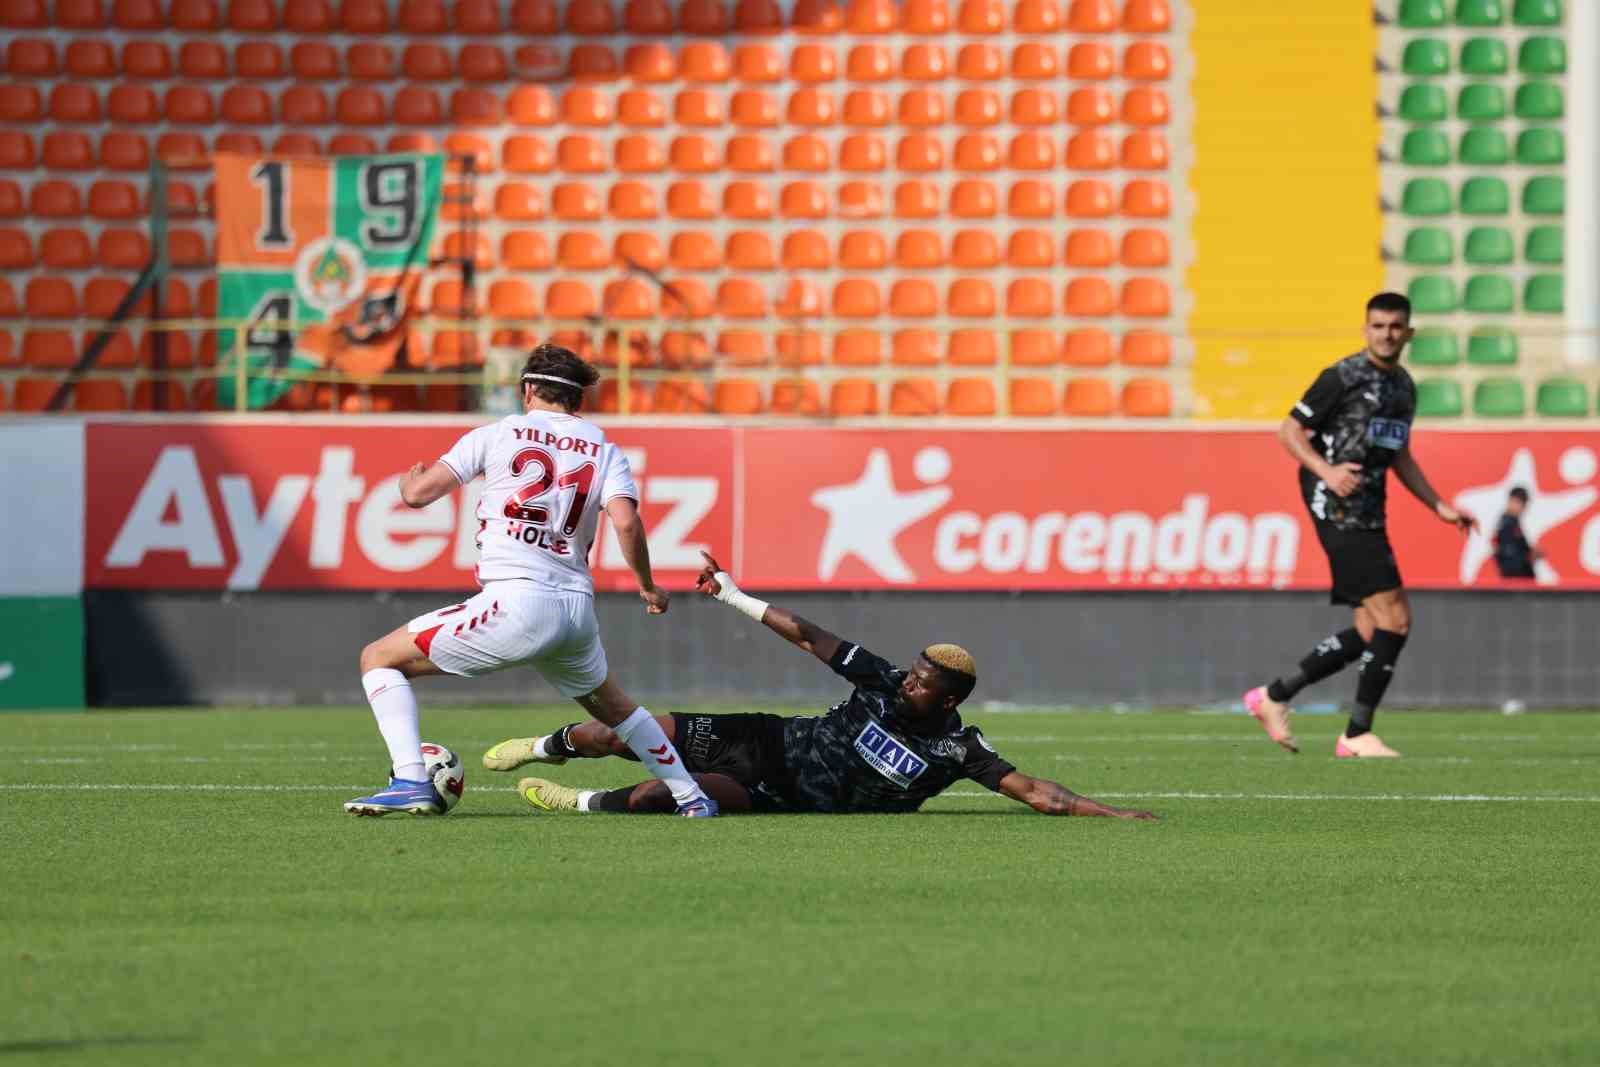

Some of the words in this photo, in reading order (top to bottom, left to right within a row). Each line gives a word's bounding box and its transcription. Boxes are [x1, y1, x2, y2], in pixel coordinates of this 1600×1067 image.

[252, 160, 292, 247] 1
[362, 160, 420, 248] 9
[247, 290, 296, 371] 4
[513, 428, 600, 457] YILPORT
[106, 446, 719, 591] Ayteiz
[503, 447, 598, 538] 21
[933, 494, 1299, 573] corendon
[866, 730, 920, 774] TAV
